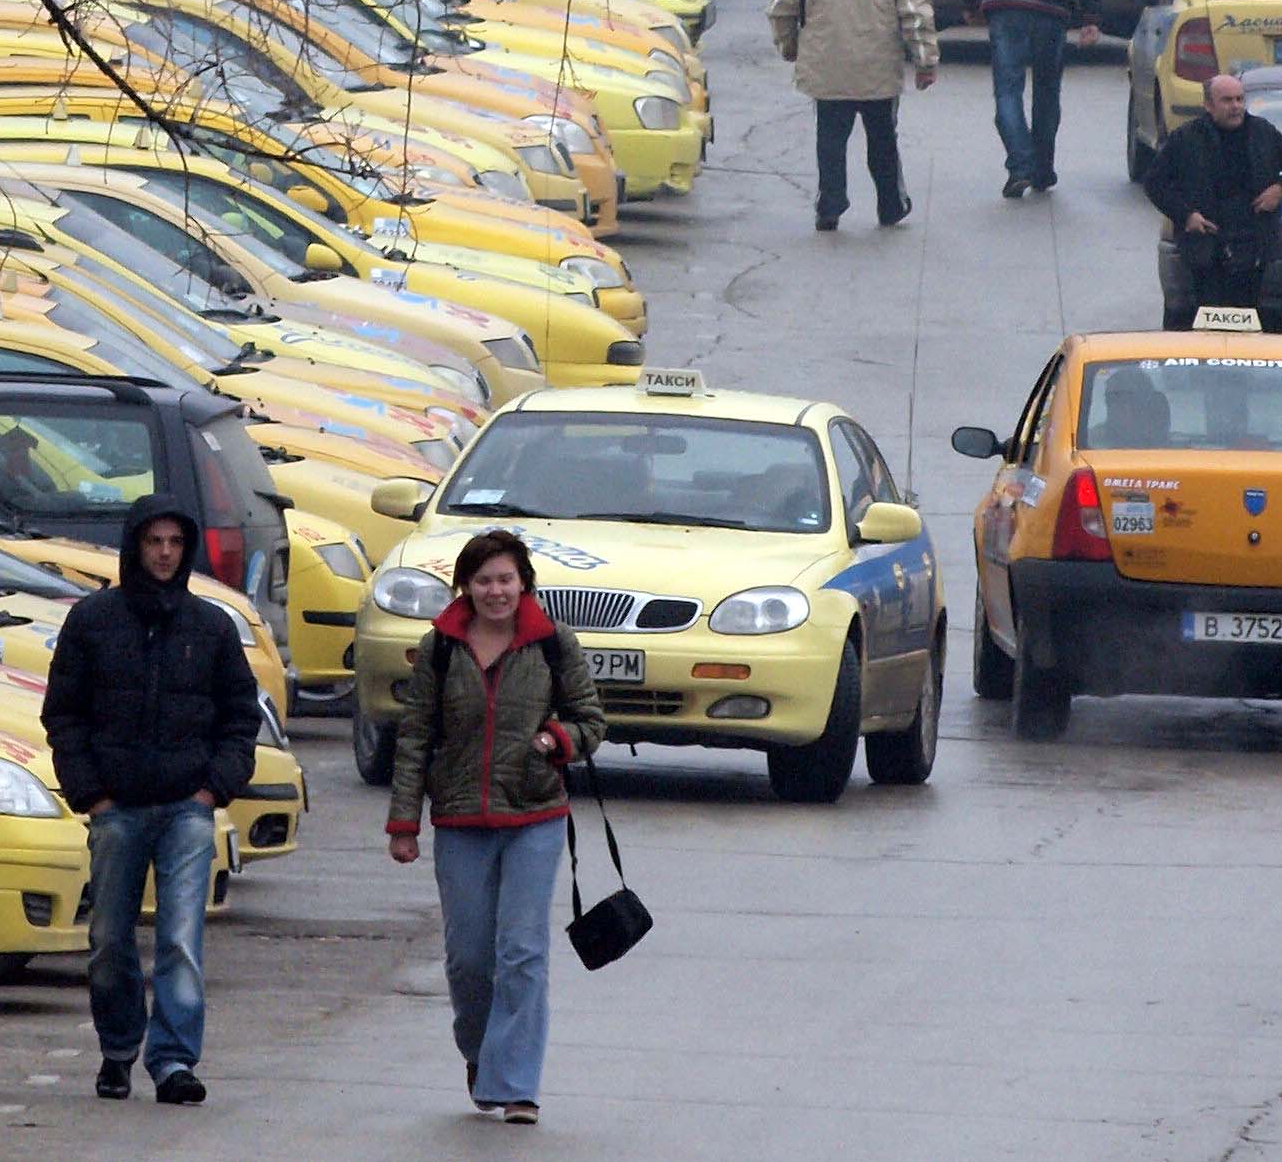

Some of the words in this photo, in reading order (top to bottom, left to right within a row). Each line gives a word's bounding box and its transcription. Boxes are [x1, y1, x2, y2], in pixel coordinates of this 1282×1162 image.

[1203, 312, 1252, 324] ТАКСИ
[1164, 358, 1199, 367] AIR
[645, 373, 696, 387] ТАКСИ
[1204, 616, 1218, 637] B
